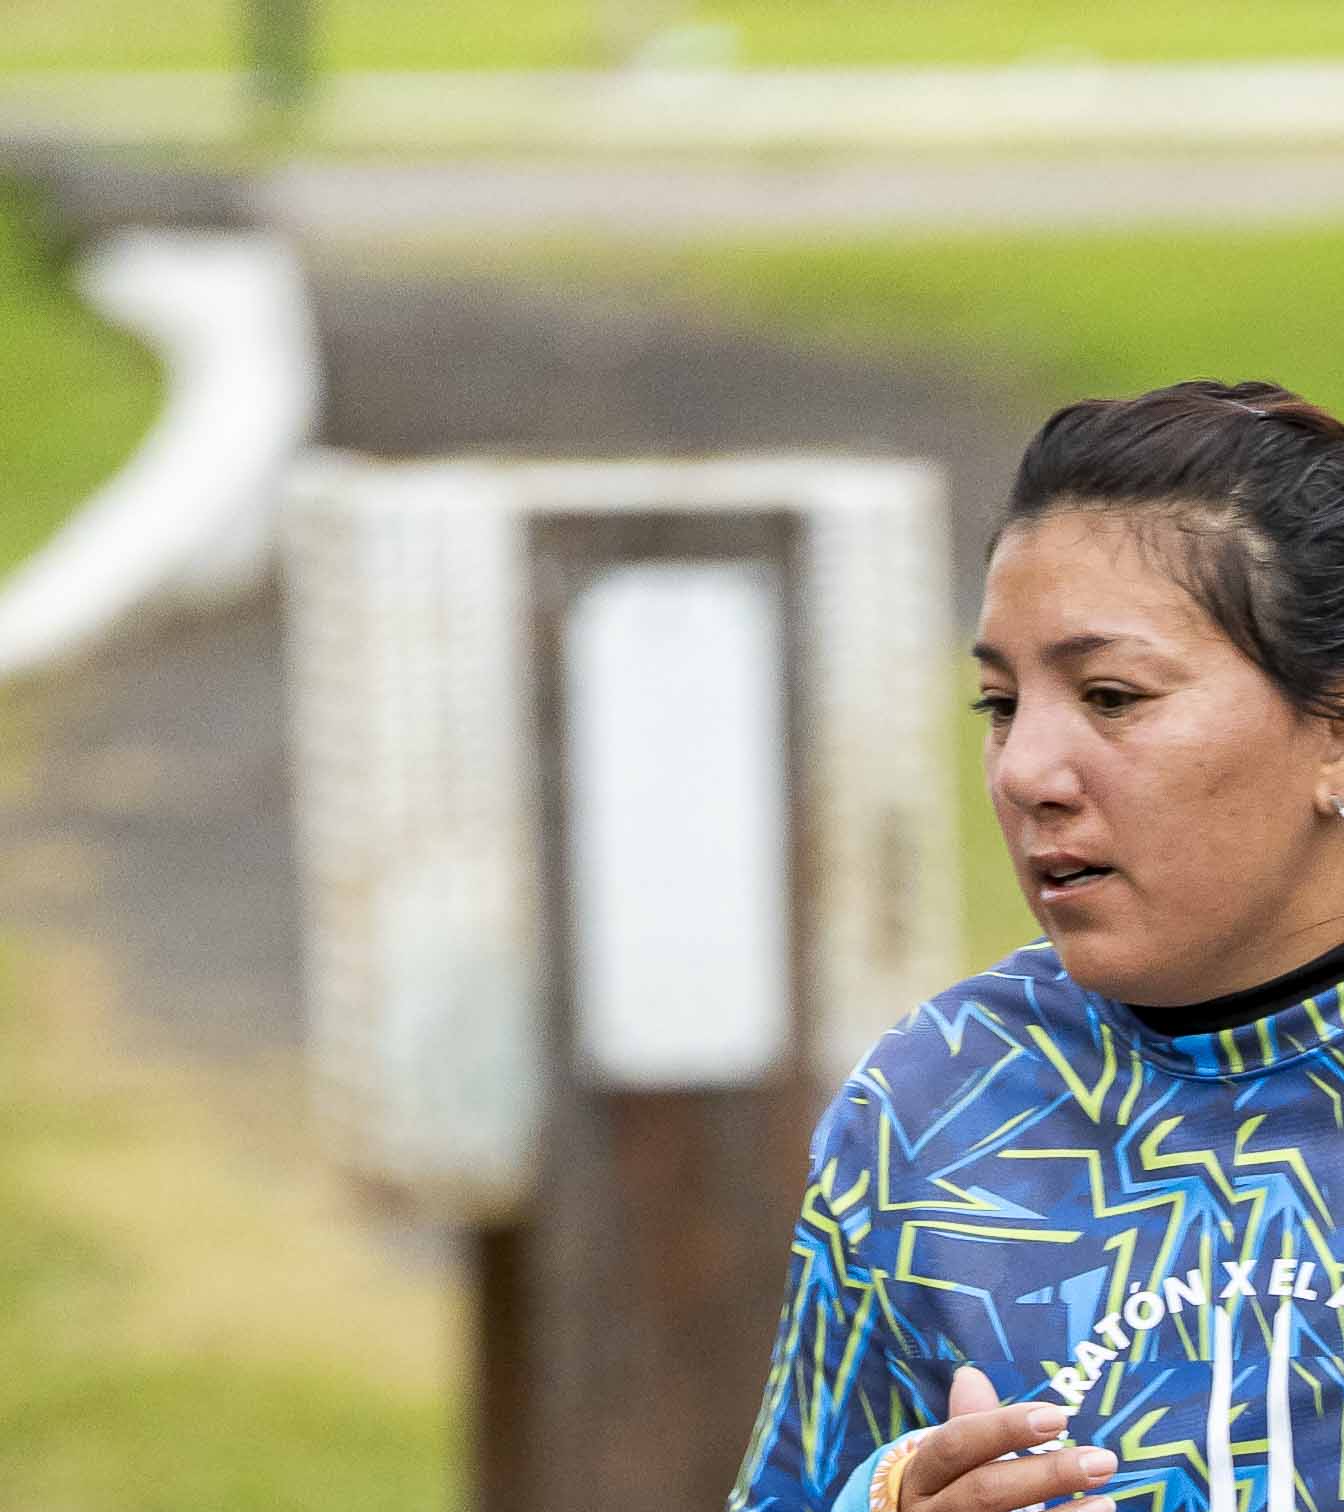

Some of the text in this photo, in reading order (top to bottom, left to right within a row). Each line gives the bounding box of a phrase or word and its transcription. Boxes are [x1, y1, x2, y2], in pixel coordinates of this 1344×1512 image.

[1000, 1269, 1207, 1460] RATÓN
[1219, 1260, 1257, 1298] X
[1268, 1259, 1318, 1300] EL
